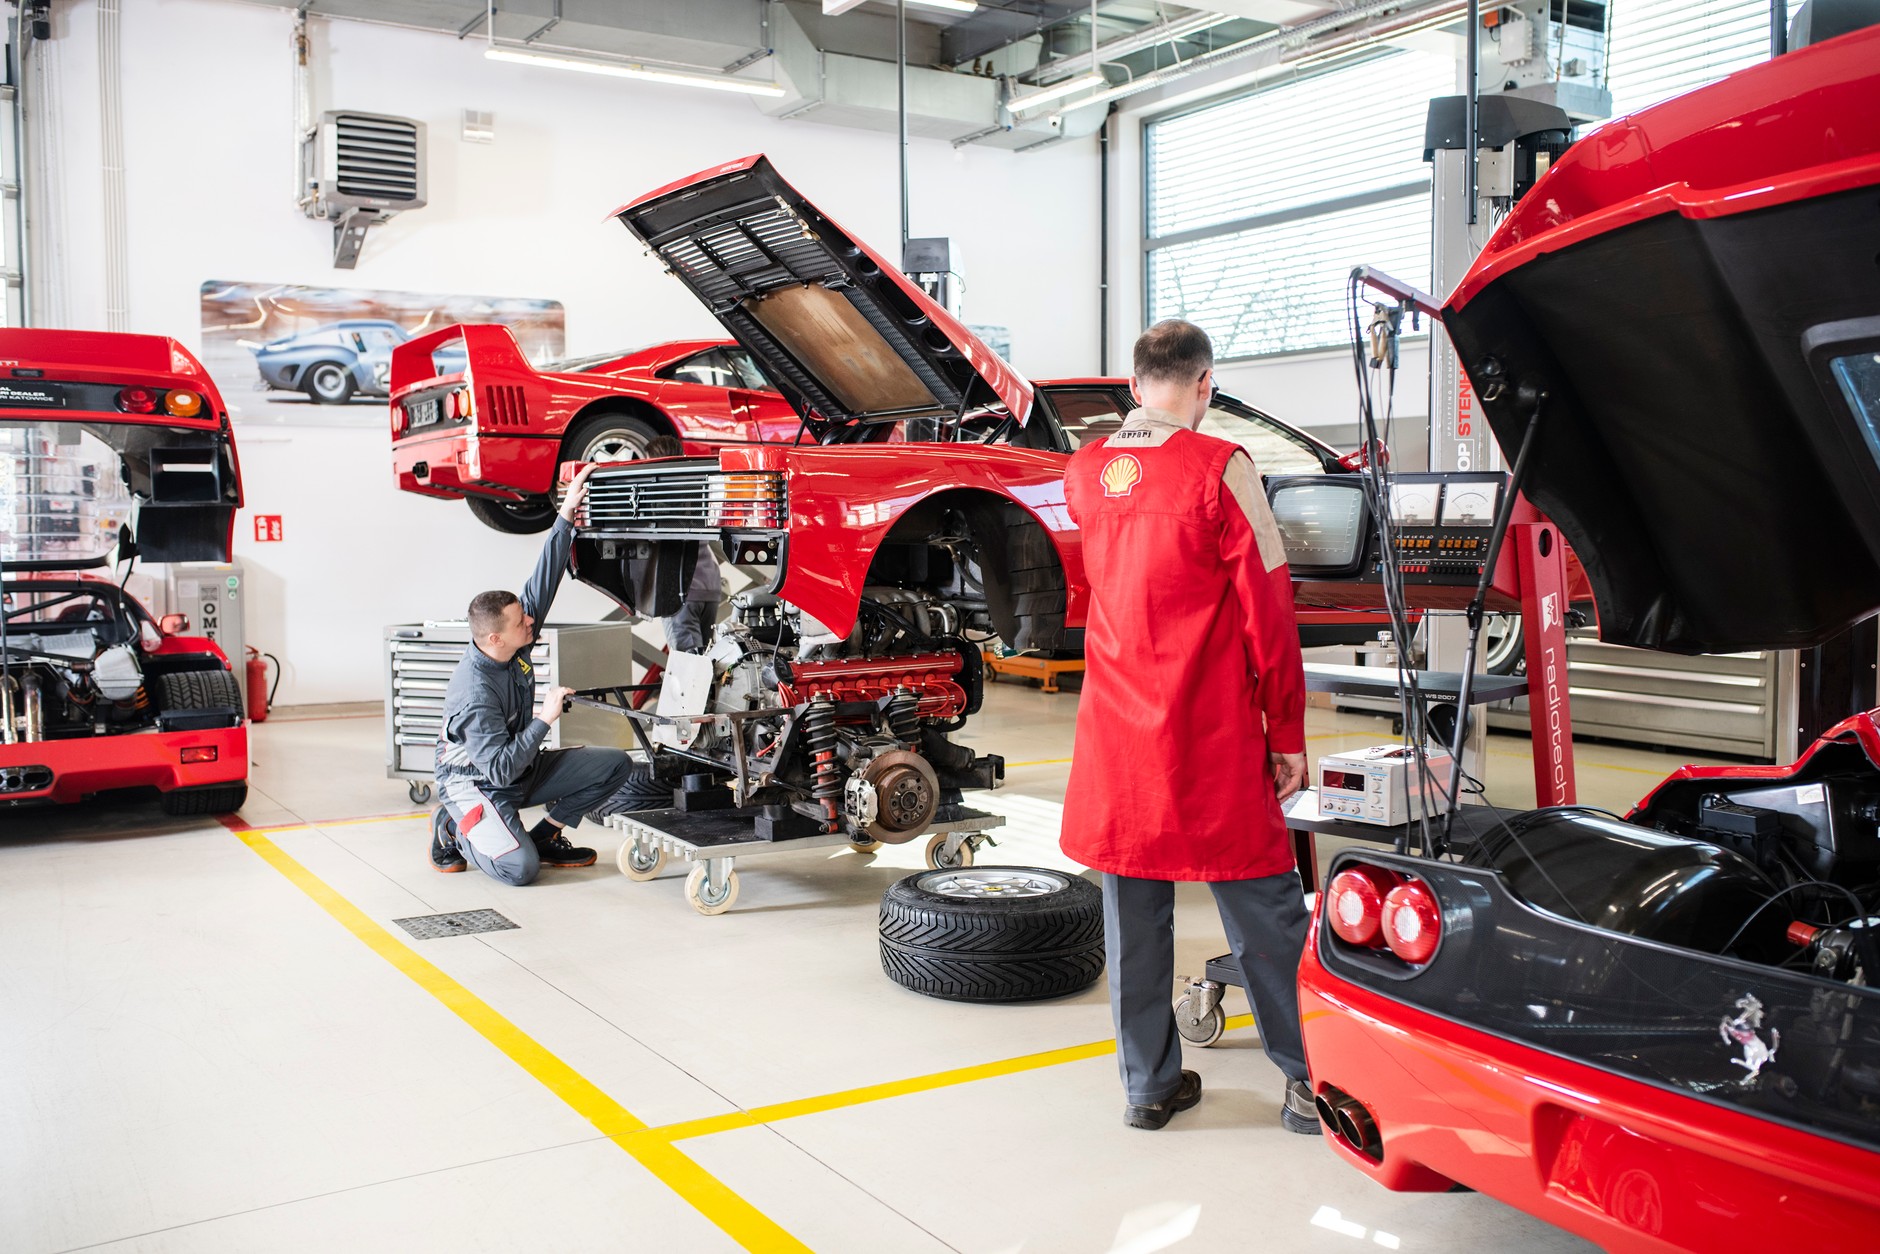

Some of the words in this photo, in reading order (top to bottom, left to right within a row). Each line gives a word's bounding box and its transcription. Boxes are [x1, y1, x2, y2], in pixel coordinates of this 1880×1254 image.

[1458, 360, 1472, 437] STENH
[1457, 443, 1471, 472] OP
[1545, 647, 1567, 807] radiotech
